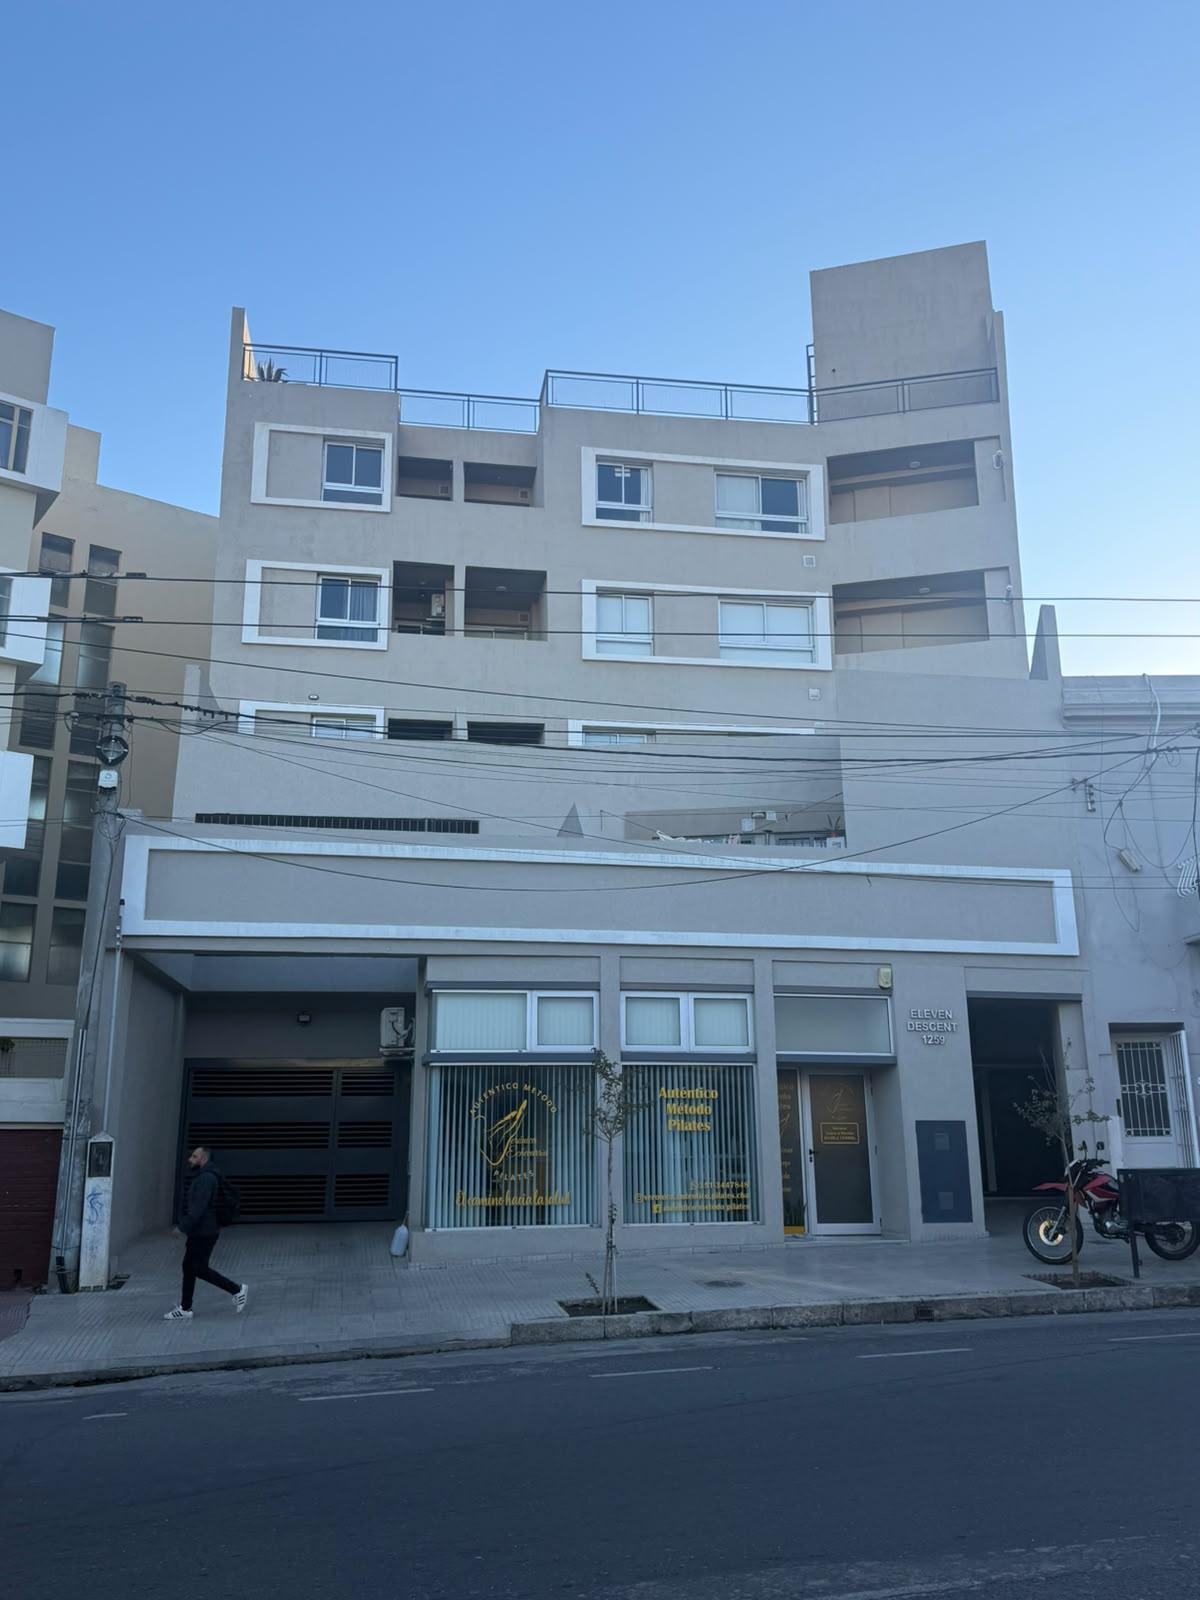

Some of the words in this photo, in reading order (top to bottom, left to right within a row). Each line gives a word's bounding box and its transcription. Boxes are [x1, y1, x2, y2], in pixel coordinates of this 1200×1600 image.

[910, 1008, 953, 1019] ELEVEN
[907, 1021, 958, 1032] DESCENT
[922, 1034, 945, 1045] 1259
[523, 1083, 558, 1114] METODO
[668, 1119, 712, 1132] Pilates
[493, 1168, 536, 1181] PILATES
